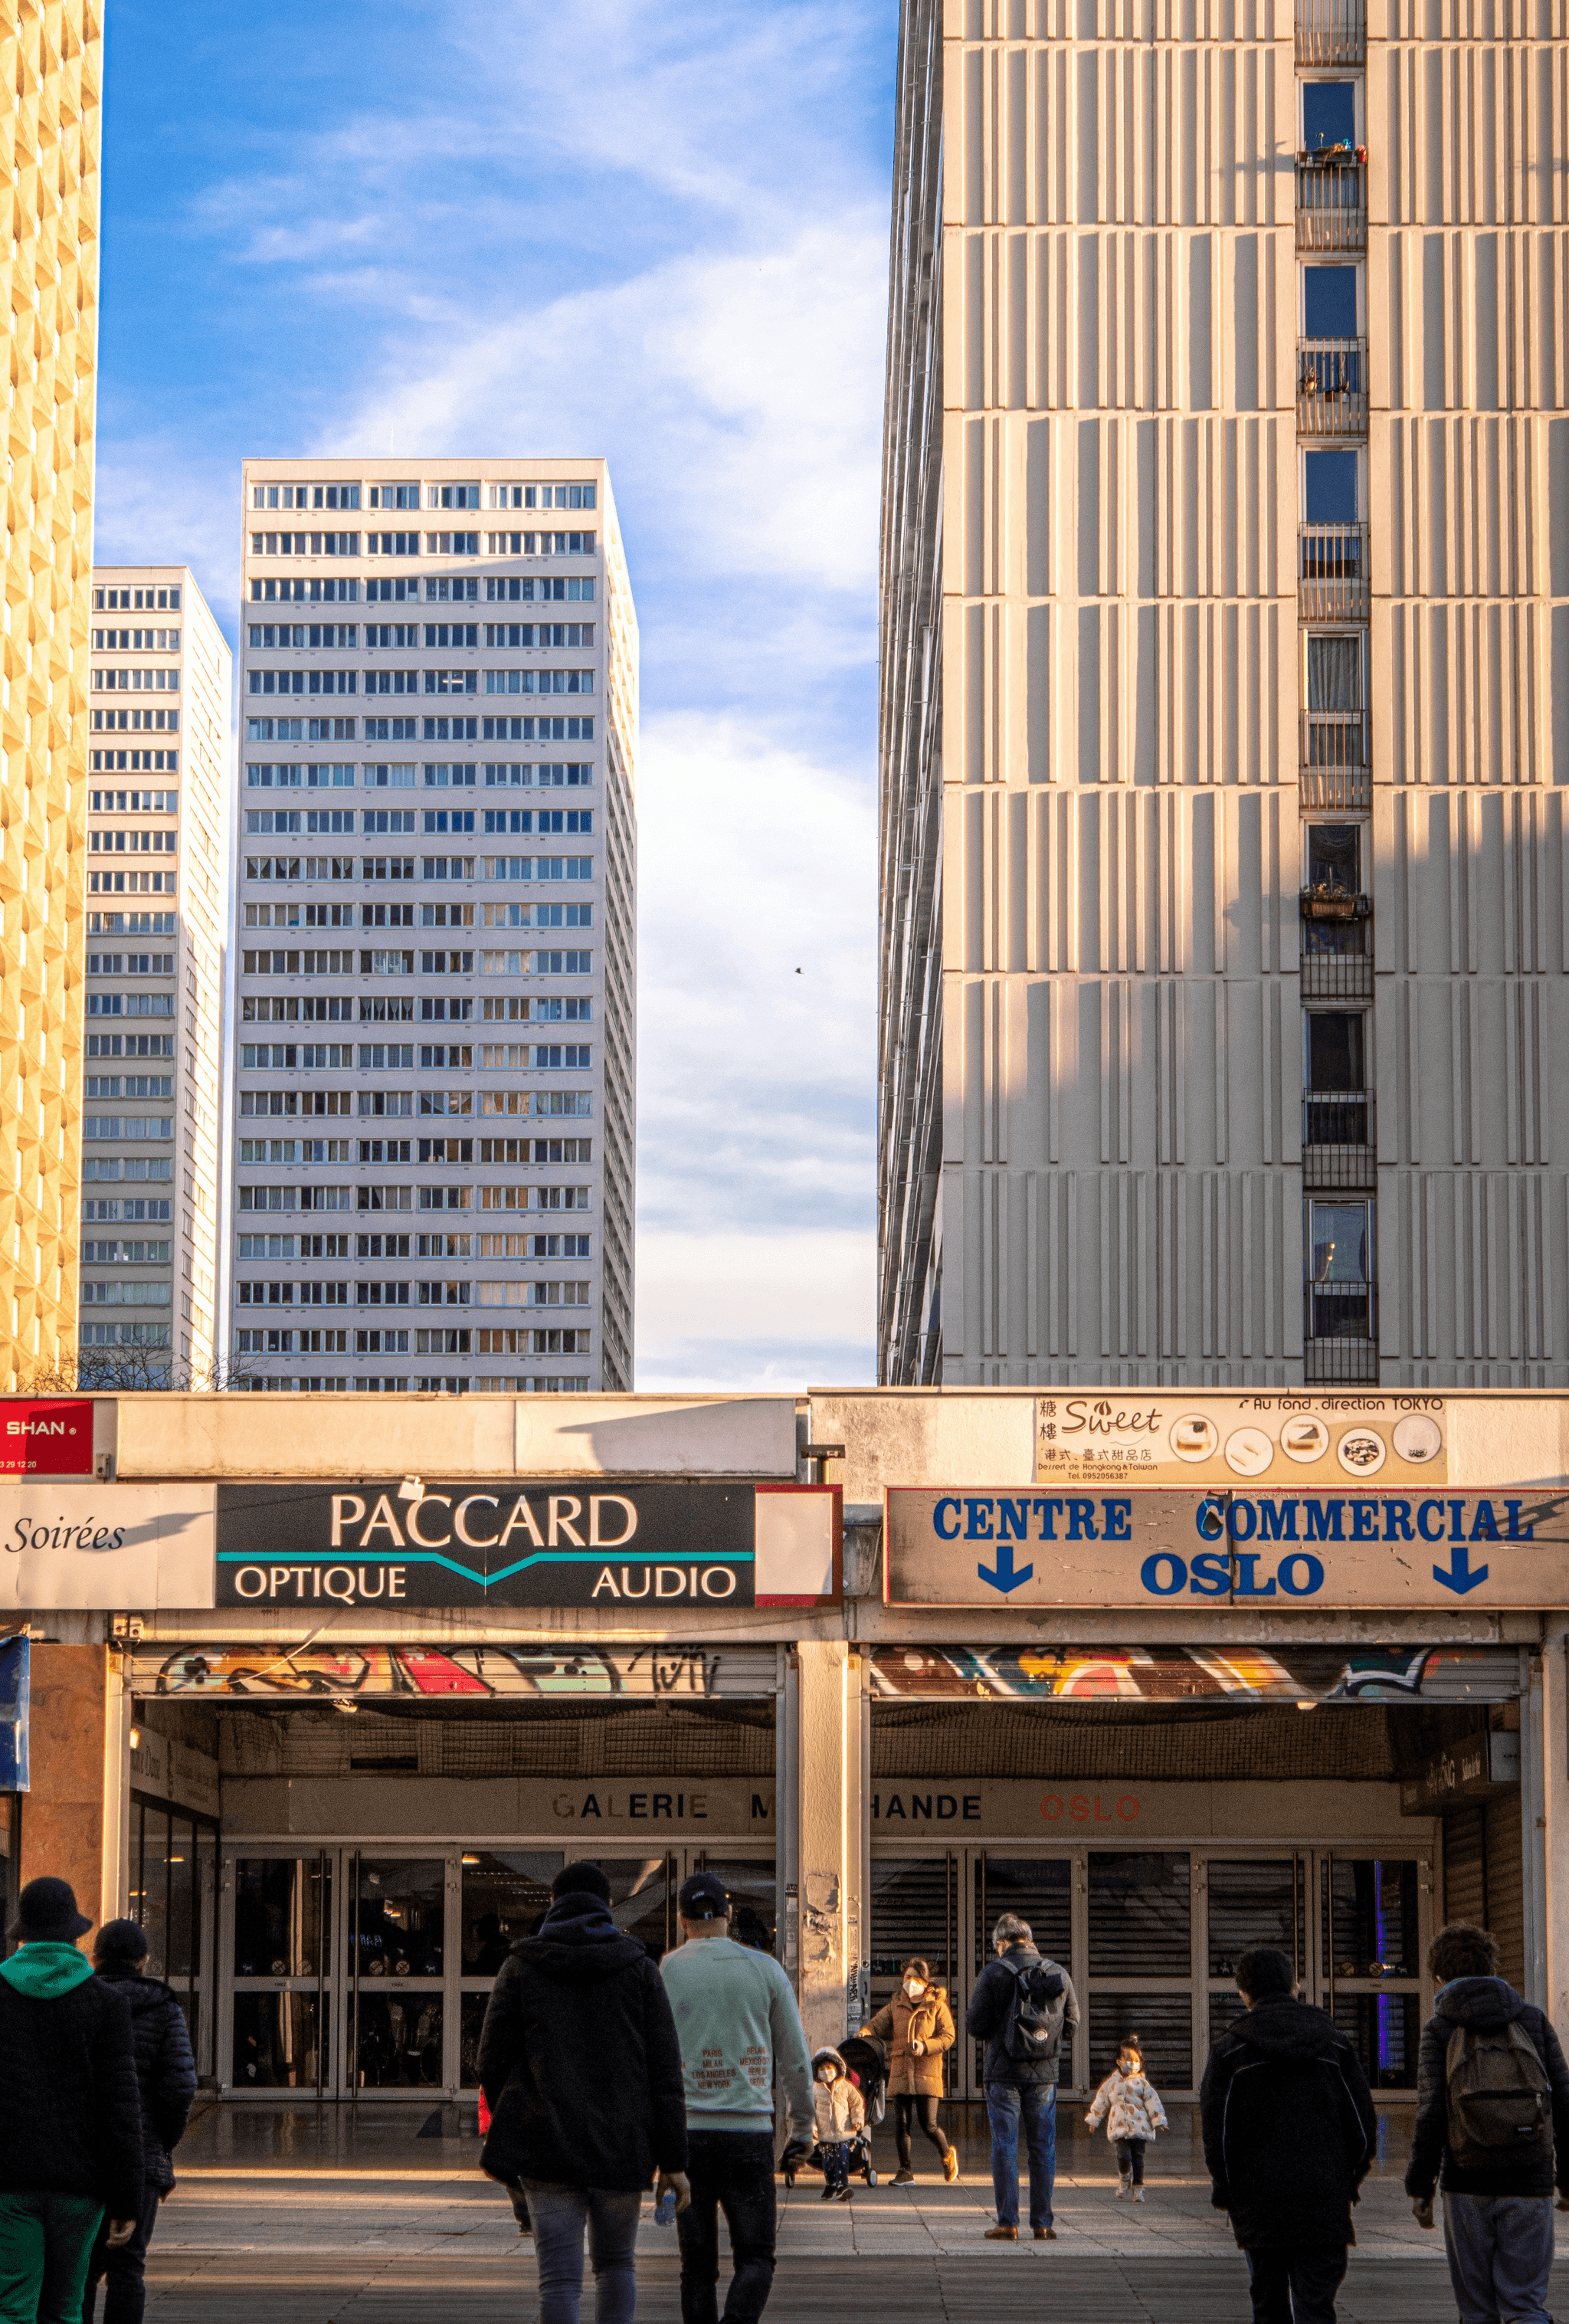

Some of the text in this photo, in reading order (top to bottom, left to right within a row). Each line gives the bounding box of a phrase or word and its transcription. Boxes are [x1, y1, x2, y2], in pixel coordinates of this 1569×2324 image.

[1061, 1400, 1163, 1435] Sweet
[1253, 1398, 1272, 1411] Au
[1278, 1398, 1312, 1411] fond
[1322, 1398, 1385, 1411] direction
[1393, 1398, 1443, 1411] TOKYO
[6, 1421, 65, 1435] SHAN
[5, 1516, 126, 1552] Soirées
[331, 1494, 640, 1548] PACCARD
[932, 1497, 1534, 1542] CENTRE COMMERCIAL
[234, 1566, 407, 1605] OPTIQUE
[591, 1566, 737, 1598] AUDIO
[1140, 1552, 1325, 1596] OSLO
[552, 1793, 708, 1818] GALERIE
[1040, 1795, 1141, 1821] OSLO
[703, 2049, 722, 2058] PARIS
[703, 2059, 723, 2069] MILAN
[692, 2068, 736, 2080] LOS ANGELES
[698, 2079, 731, 2090] NEW YORK
